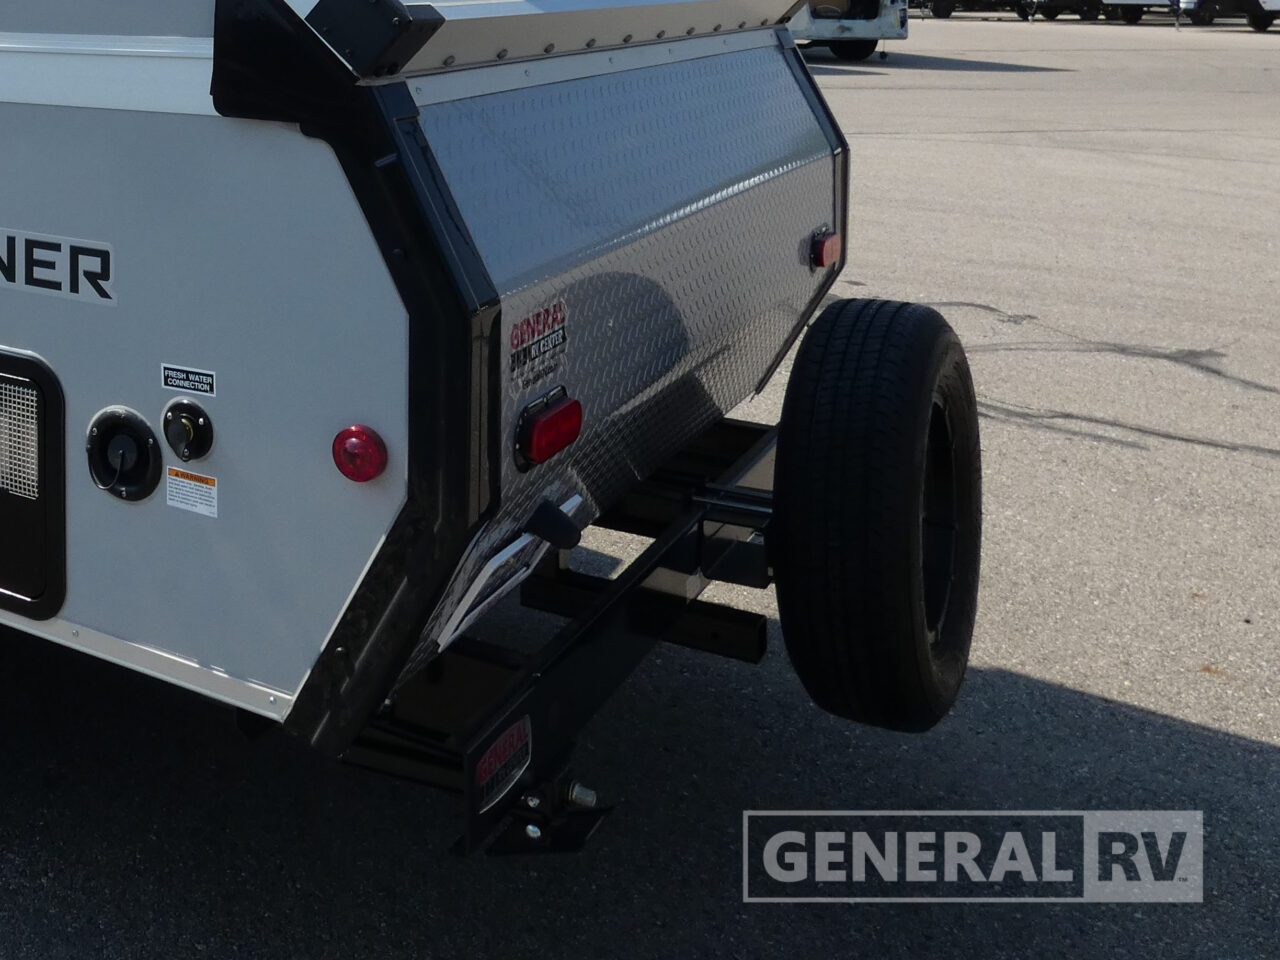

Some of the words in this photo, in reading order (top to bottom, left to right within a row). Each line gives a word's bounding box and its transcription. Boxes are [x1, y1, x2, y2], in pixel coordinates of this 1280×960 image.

[164, 370, 186, 380] FRESH
[188, 373, 213, 384] WATER
[167, 378, 210, 391] CONNECTION
